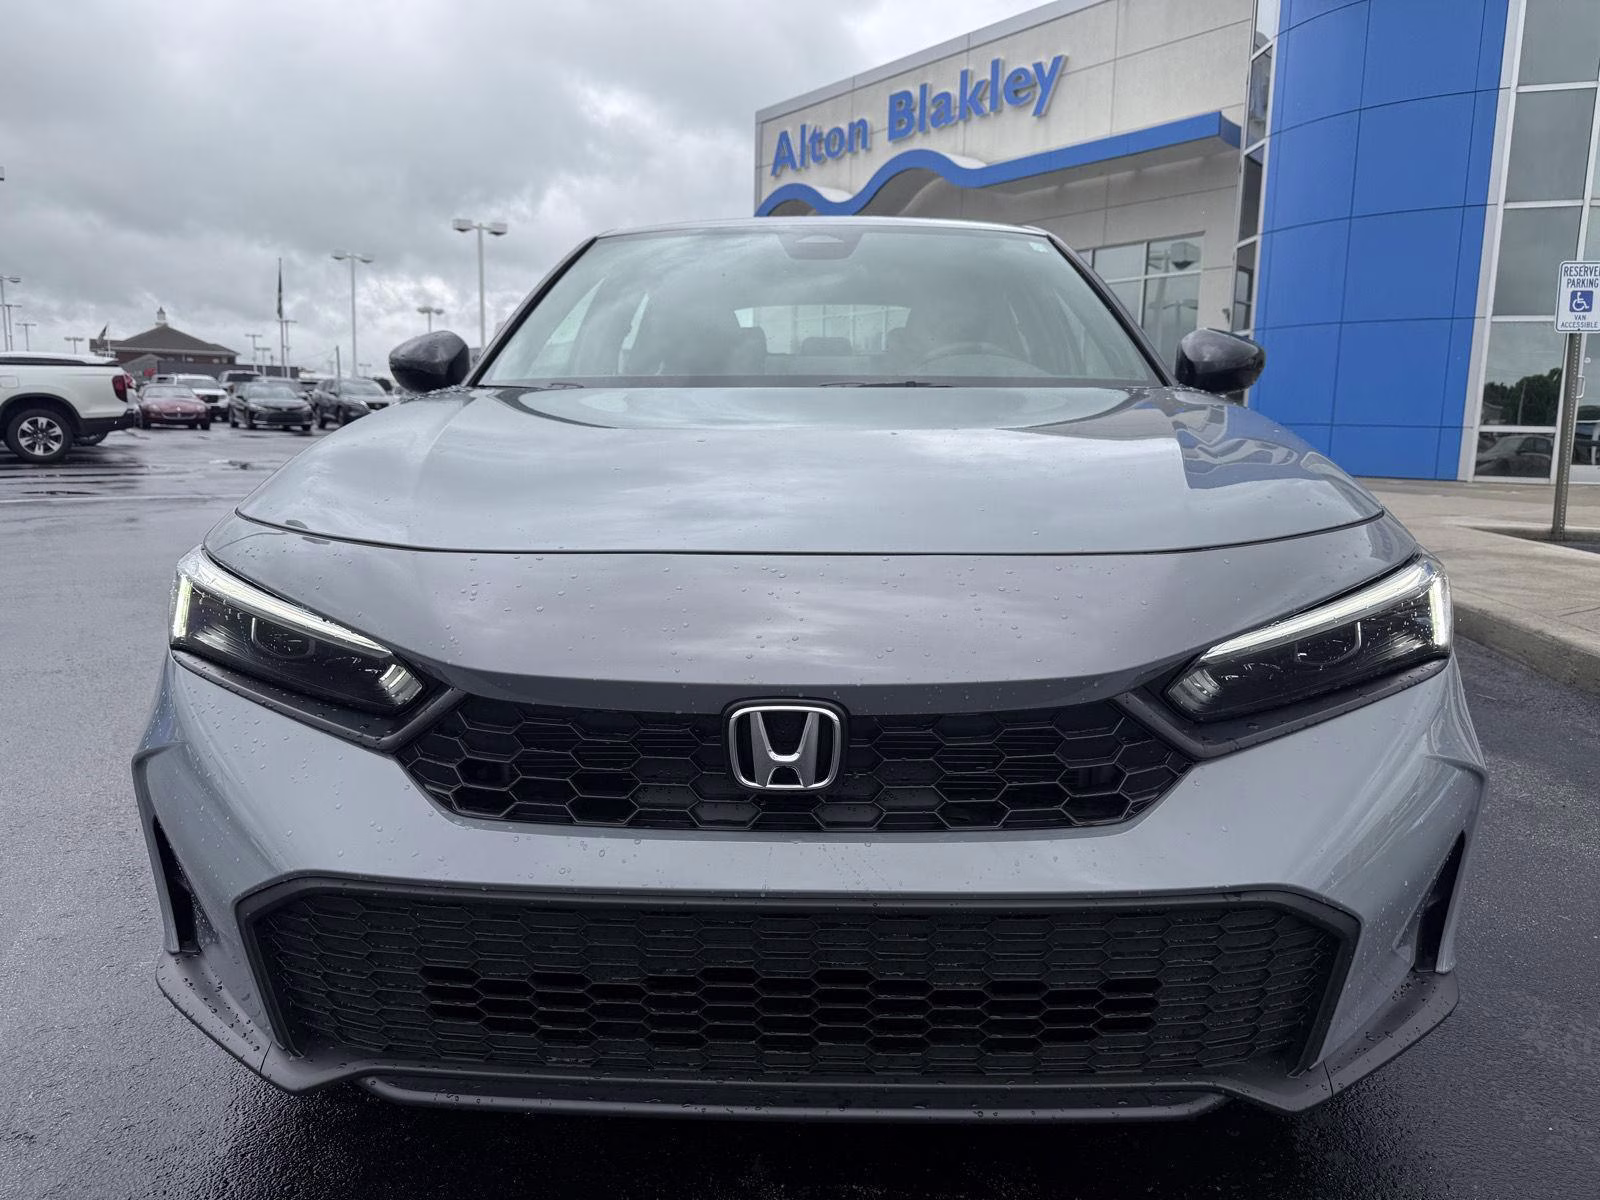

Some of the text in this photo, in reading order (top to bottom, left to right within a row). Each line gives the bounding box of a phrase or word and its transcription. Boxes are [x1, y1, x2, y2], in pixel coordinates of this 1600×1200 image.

[770, 54, 1067, 177] Alton Blakley
[1563, 265, 1600, 277] RESERVE
[1566, 278, 1599, 288] PARKING
